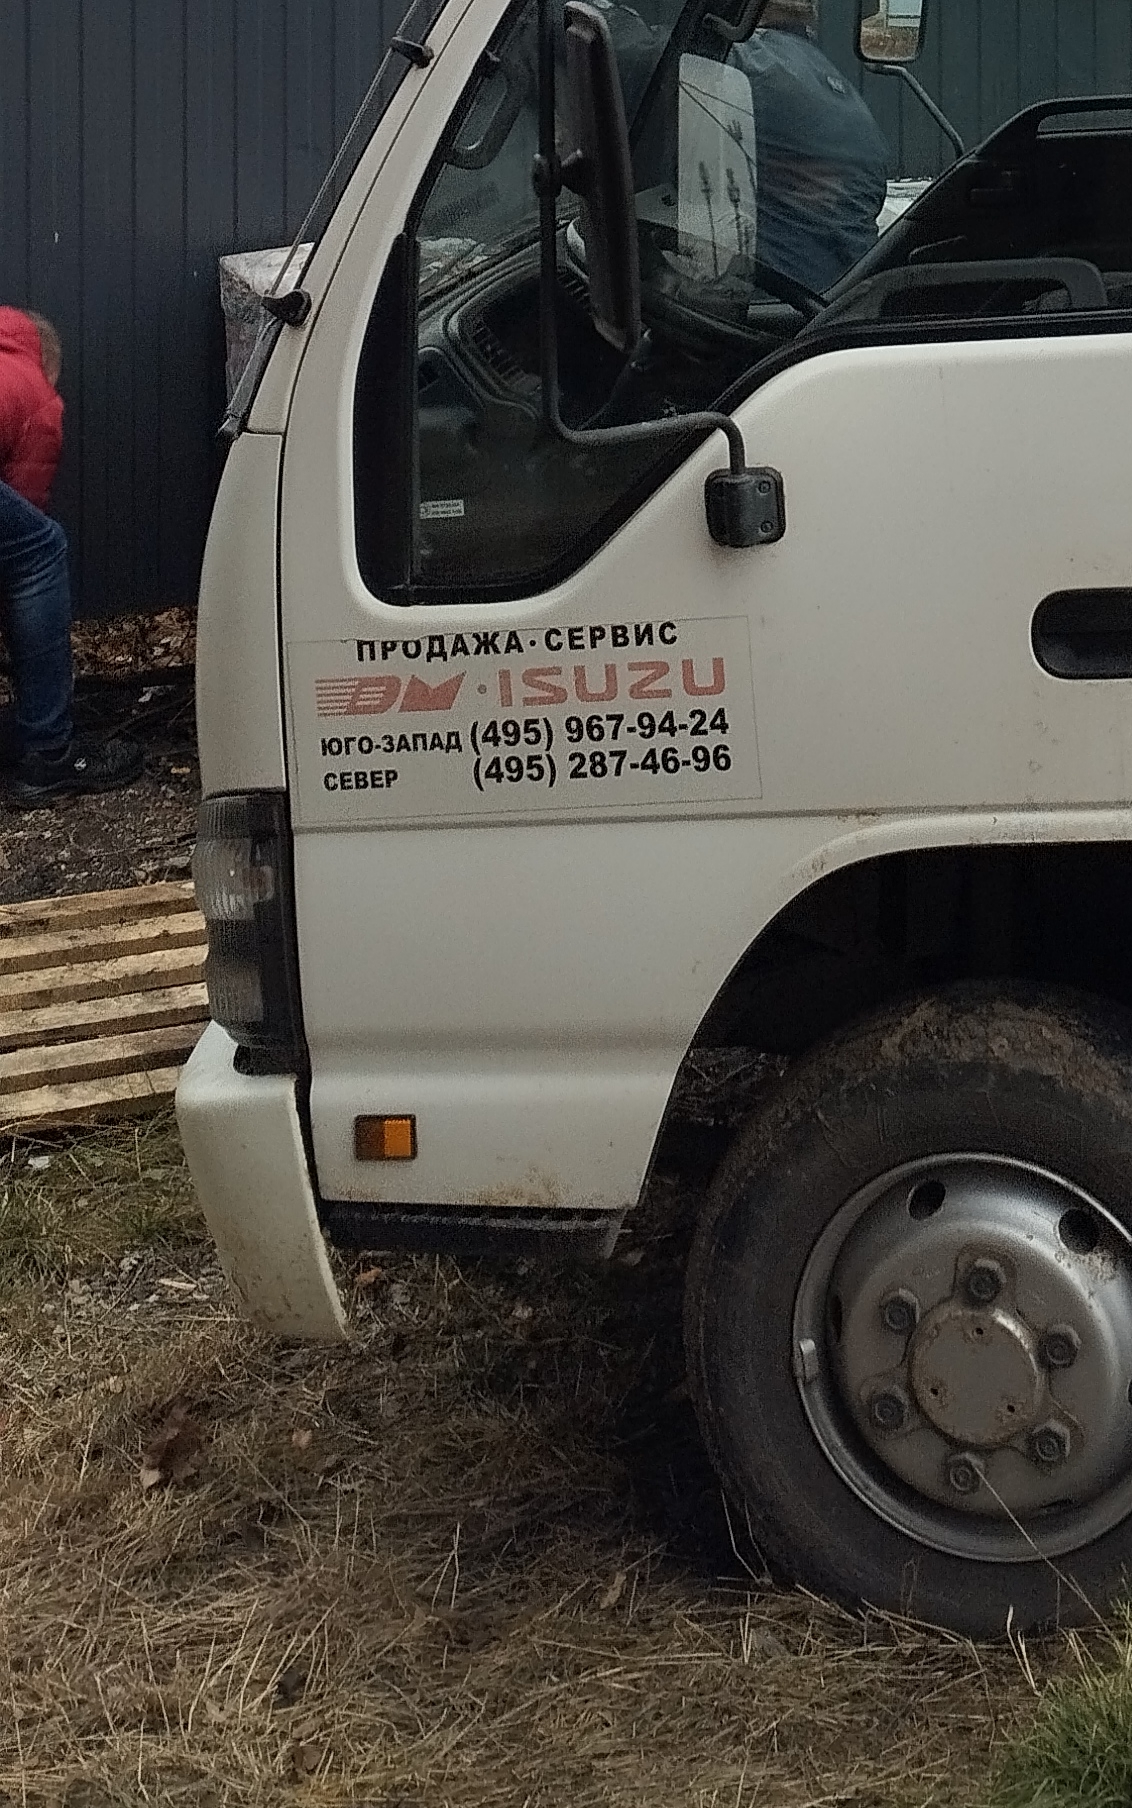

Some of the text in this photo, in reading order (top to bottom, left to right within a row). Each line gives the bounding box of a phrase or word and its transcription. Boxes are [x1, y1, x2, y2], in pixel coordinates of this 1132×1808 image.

[498, 657, 726, 708] ISUZU
[321, 708, 729, 756] ЮГО-ЗАПАД (495) 967-94-24
[324, 744, 732, 791] СЕВЕР (495) 287-46-96
